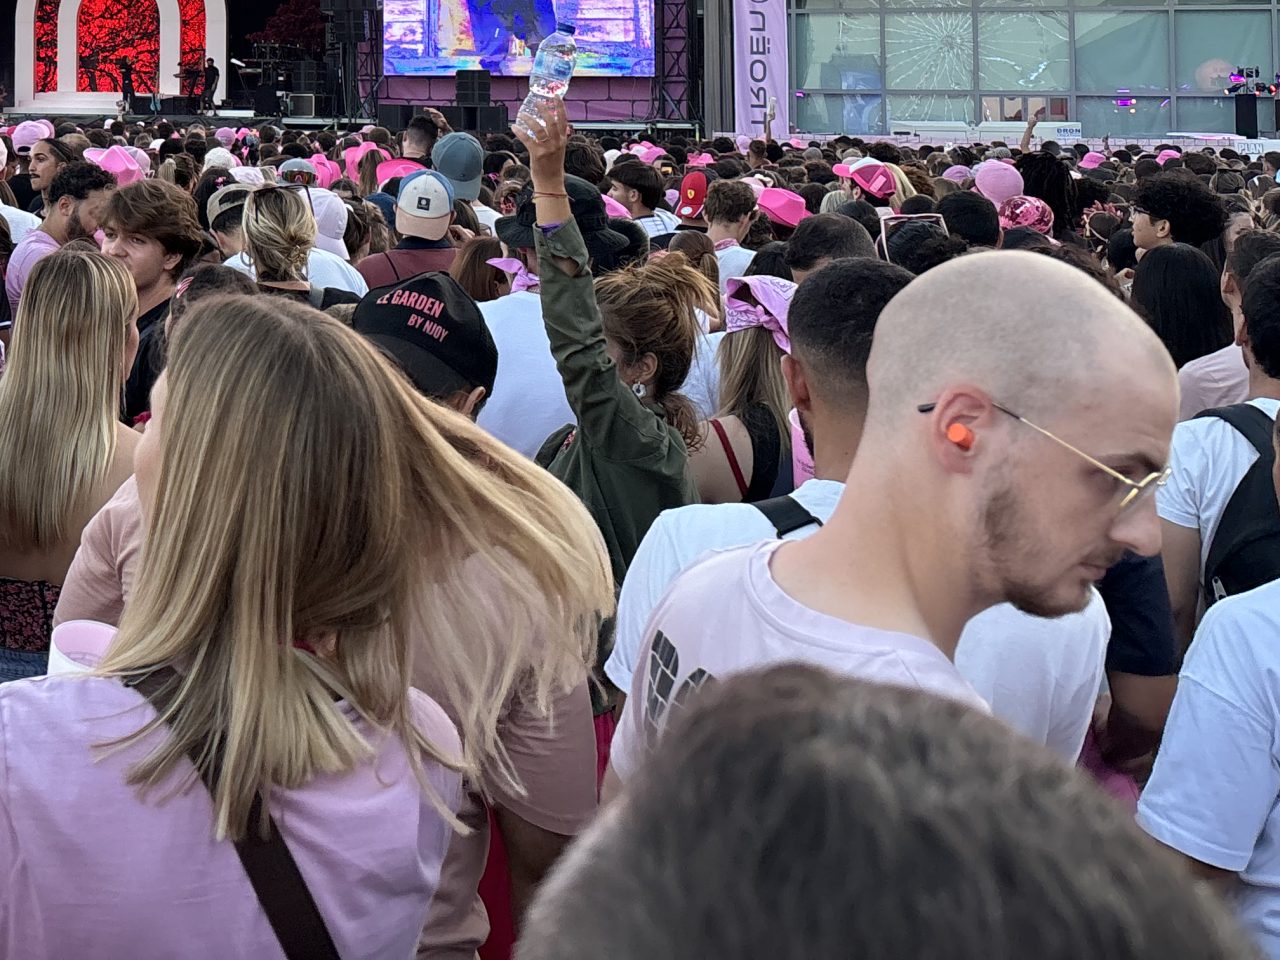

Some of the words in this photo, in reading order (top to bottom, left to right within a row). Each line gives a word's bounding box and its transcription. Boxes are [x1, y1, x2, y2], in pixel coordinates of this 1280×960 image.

[1238, 143, 1264, 155] PLAN
[391, 289, 445, 319] GARDEN
[407, 313, 424, 329] BY
[422, 321, 449, 343] NJOY
